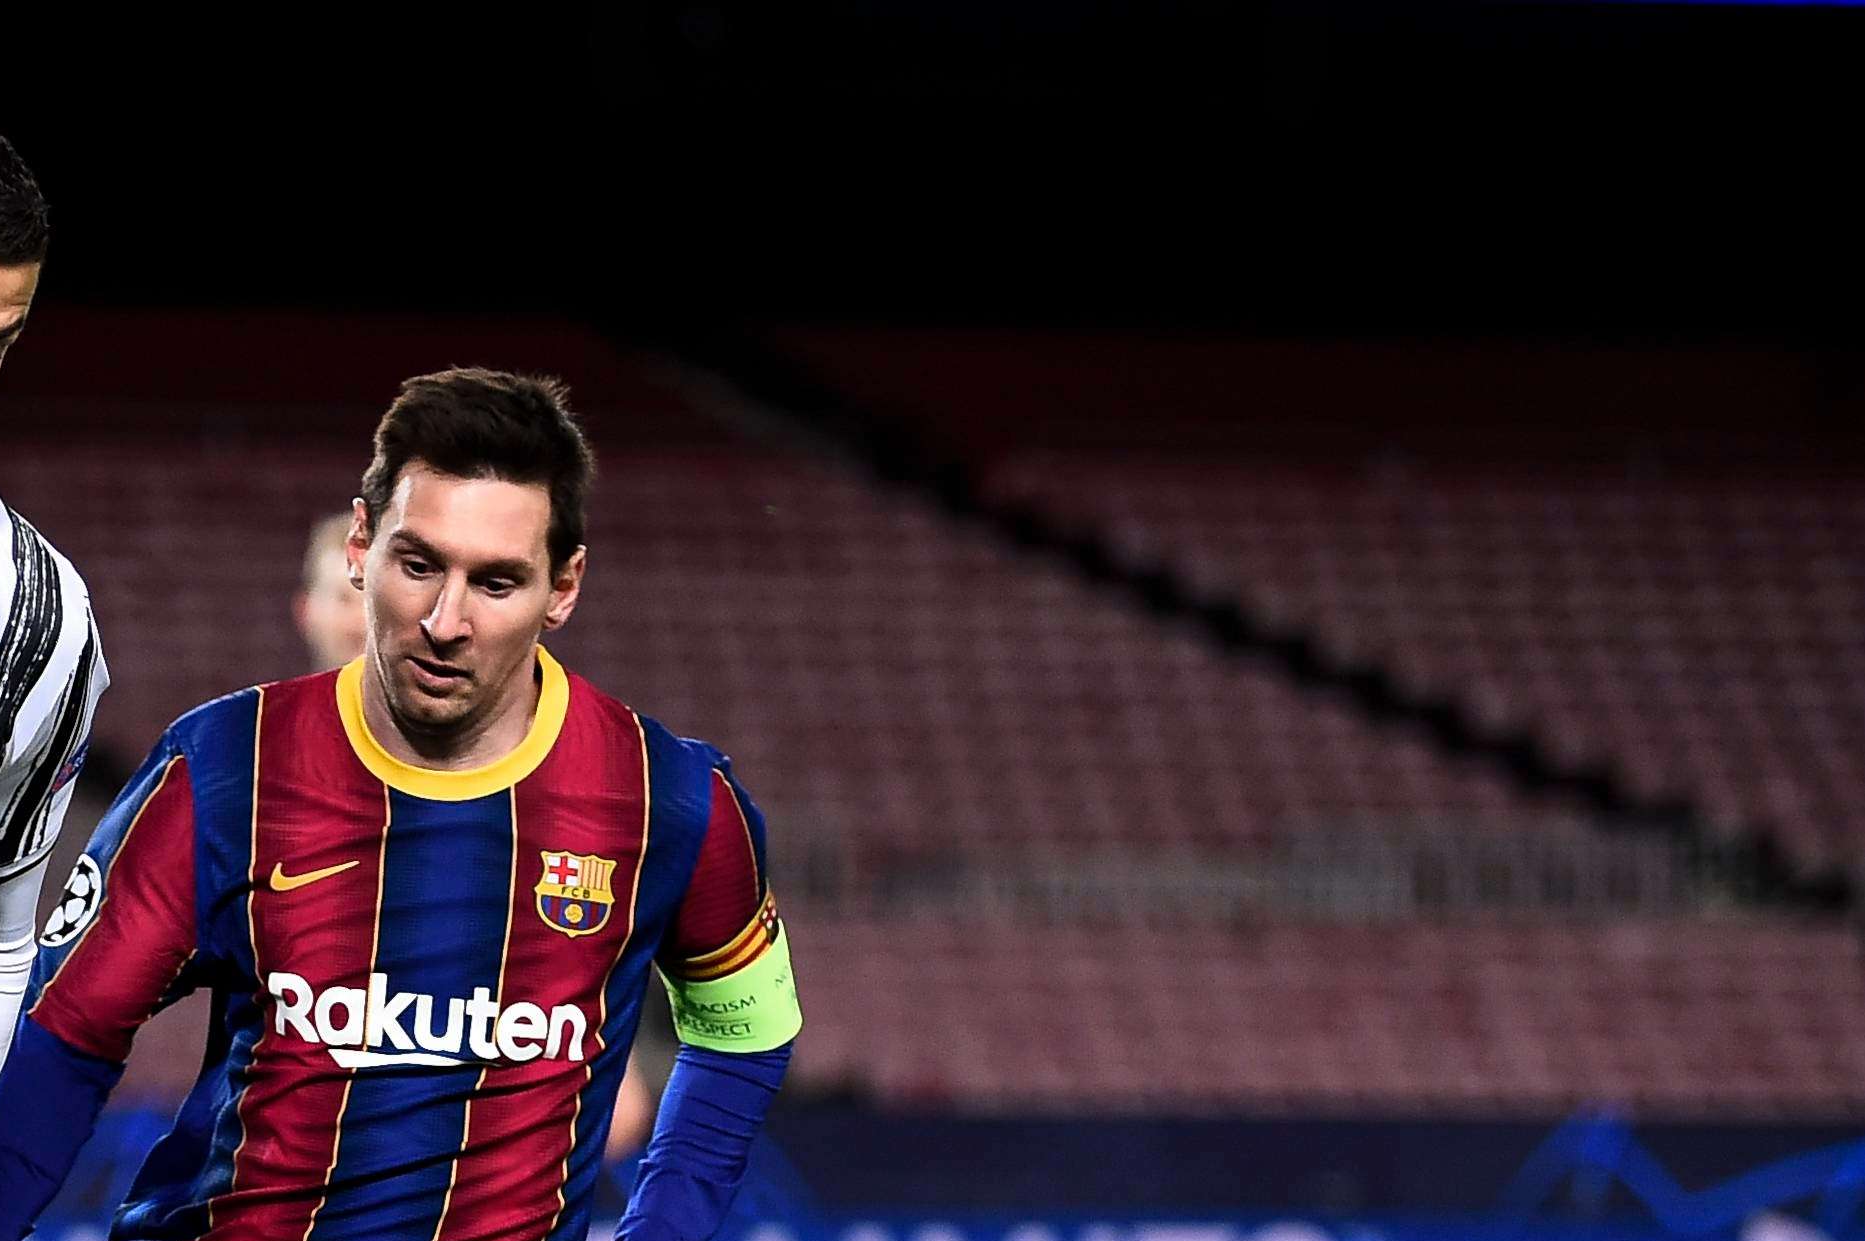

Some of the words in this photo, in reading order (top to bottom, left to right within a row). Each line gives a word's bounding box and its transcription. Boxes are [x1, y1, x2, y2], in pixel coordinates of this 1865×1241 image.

[561, 886, 591, 899] FCB
[695, 994, 756, 1014] ACISM
[267, 971, 588, 1062] Rakuten
